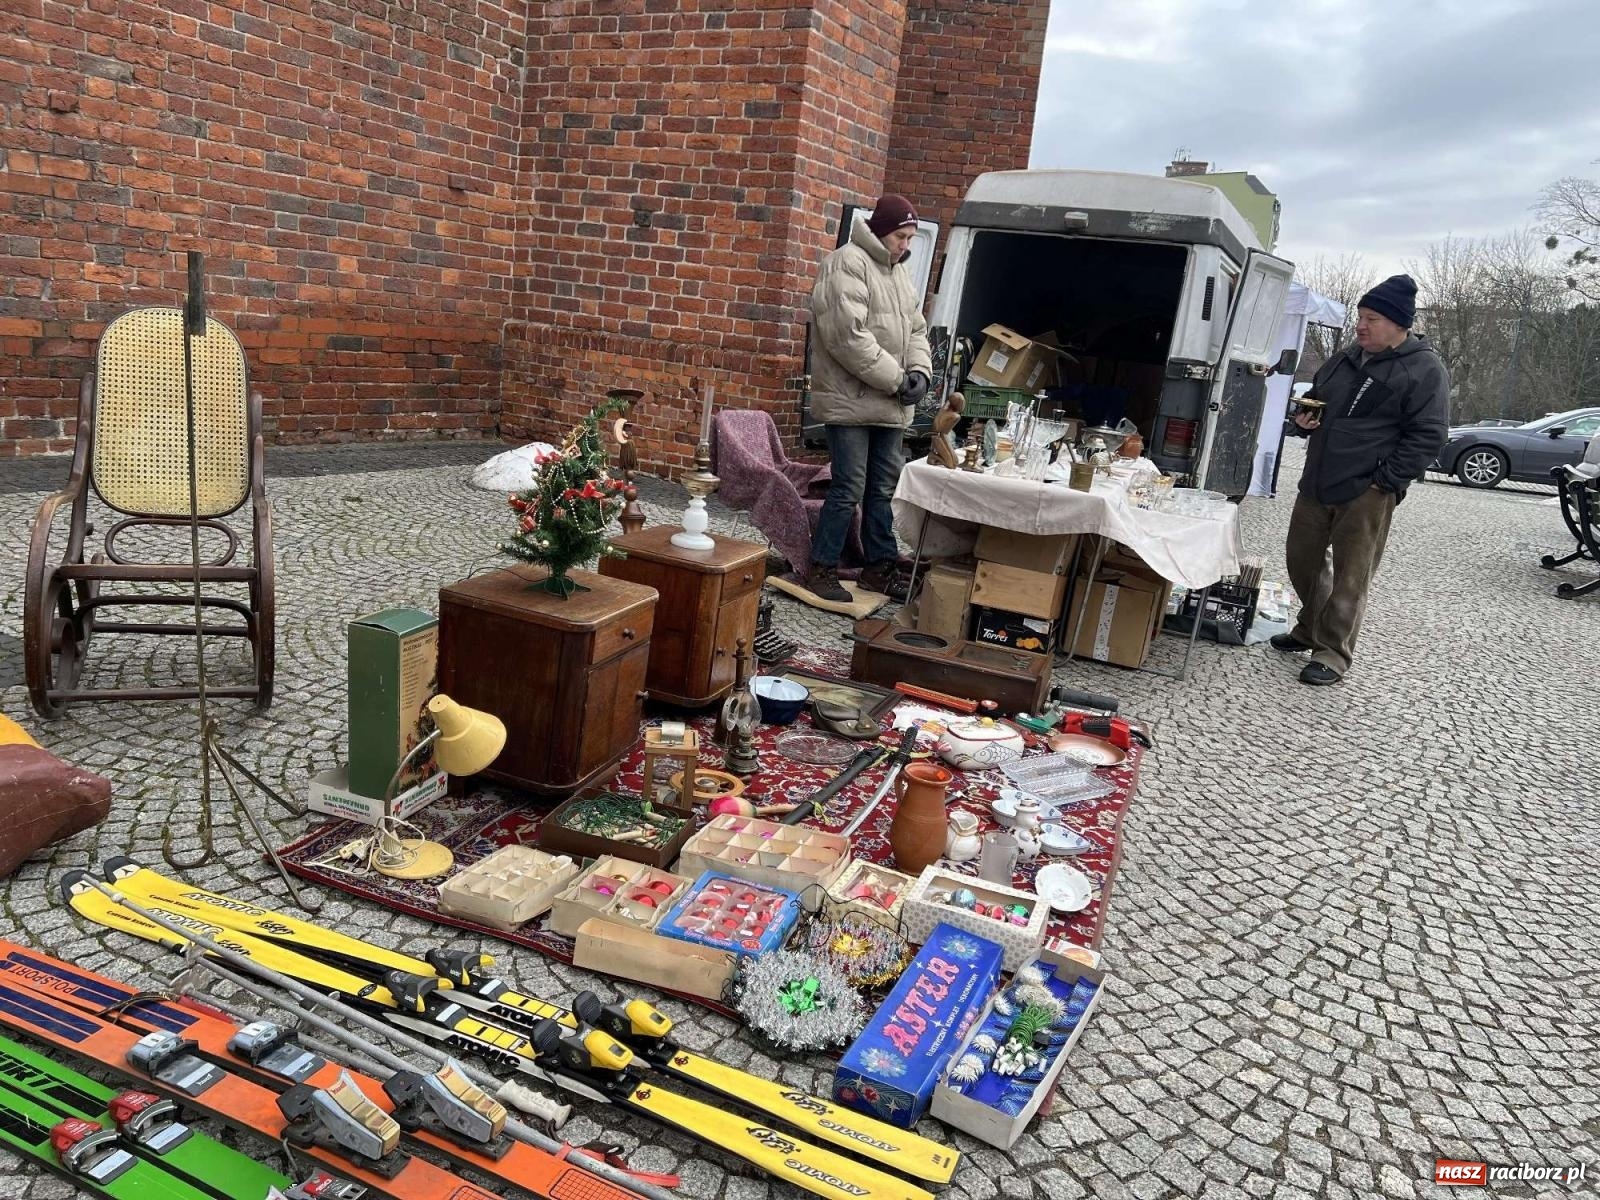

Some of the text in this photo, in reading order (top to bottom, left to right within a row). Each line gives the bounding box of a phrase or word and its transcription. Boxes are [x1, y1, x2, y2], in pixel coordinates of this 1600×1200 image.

[180, 892, 266, 917] ATOMIC
[8, 965, 78, 994] POLSPORT
[882, 956, 960, 1058] ASTER
[443, 1034, 520, 1068] ATOMIC
[818, 1118, 901, 1152] ATOMIC
[784, 1158, 871, 1195] ATOMIC
